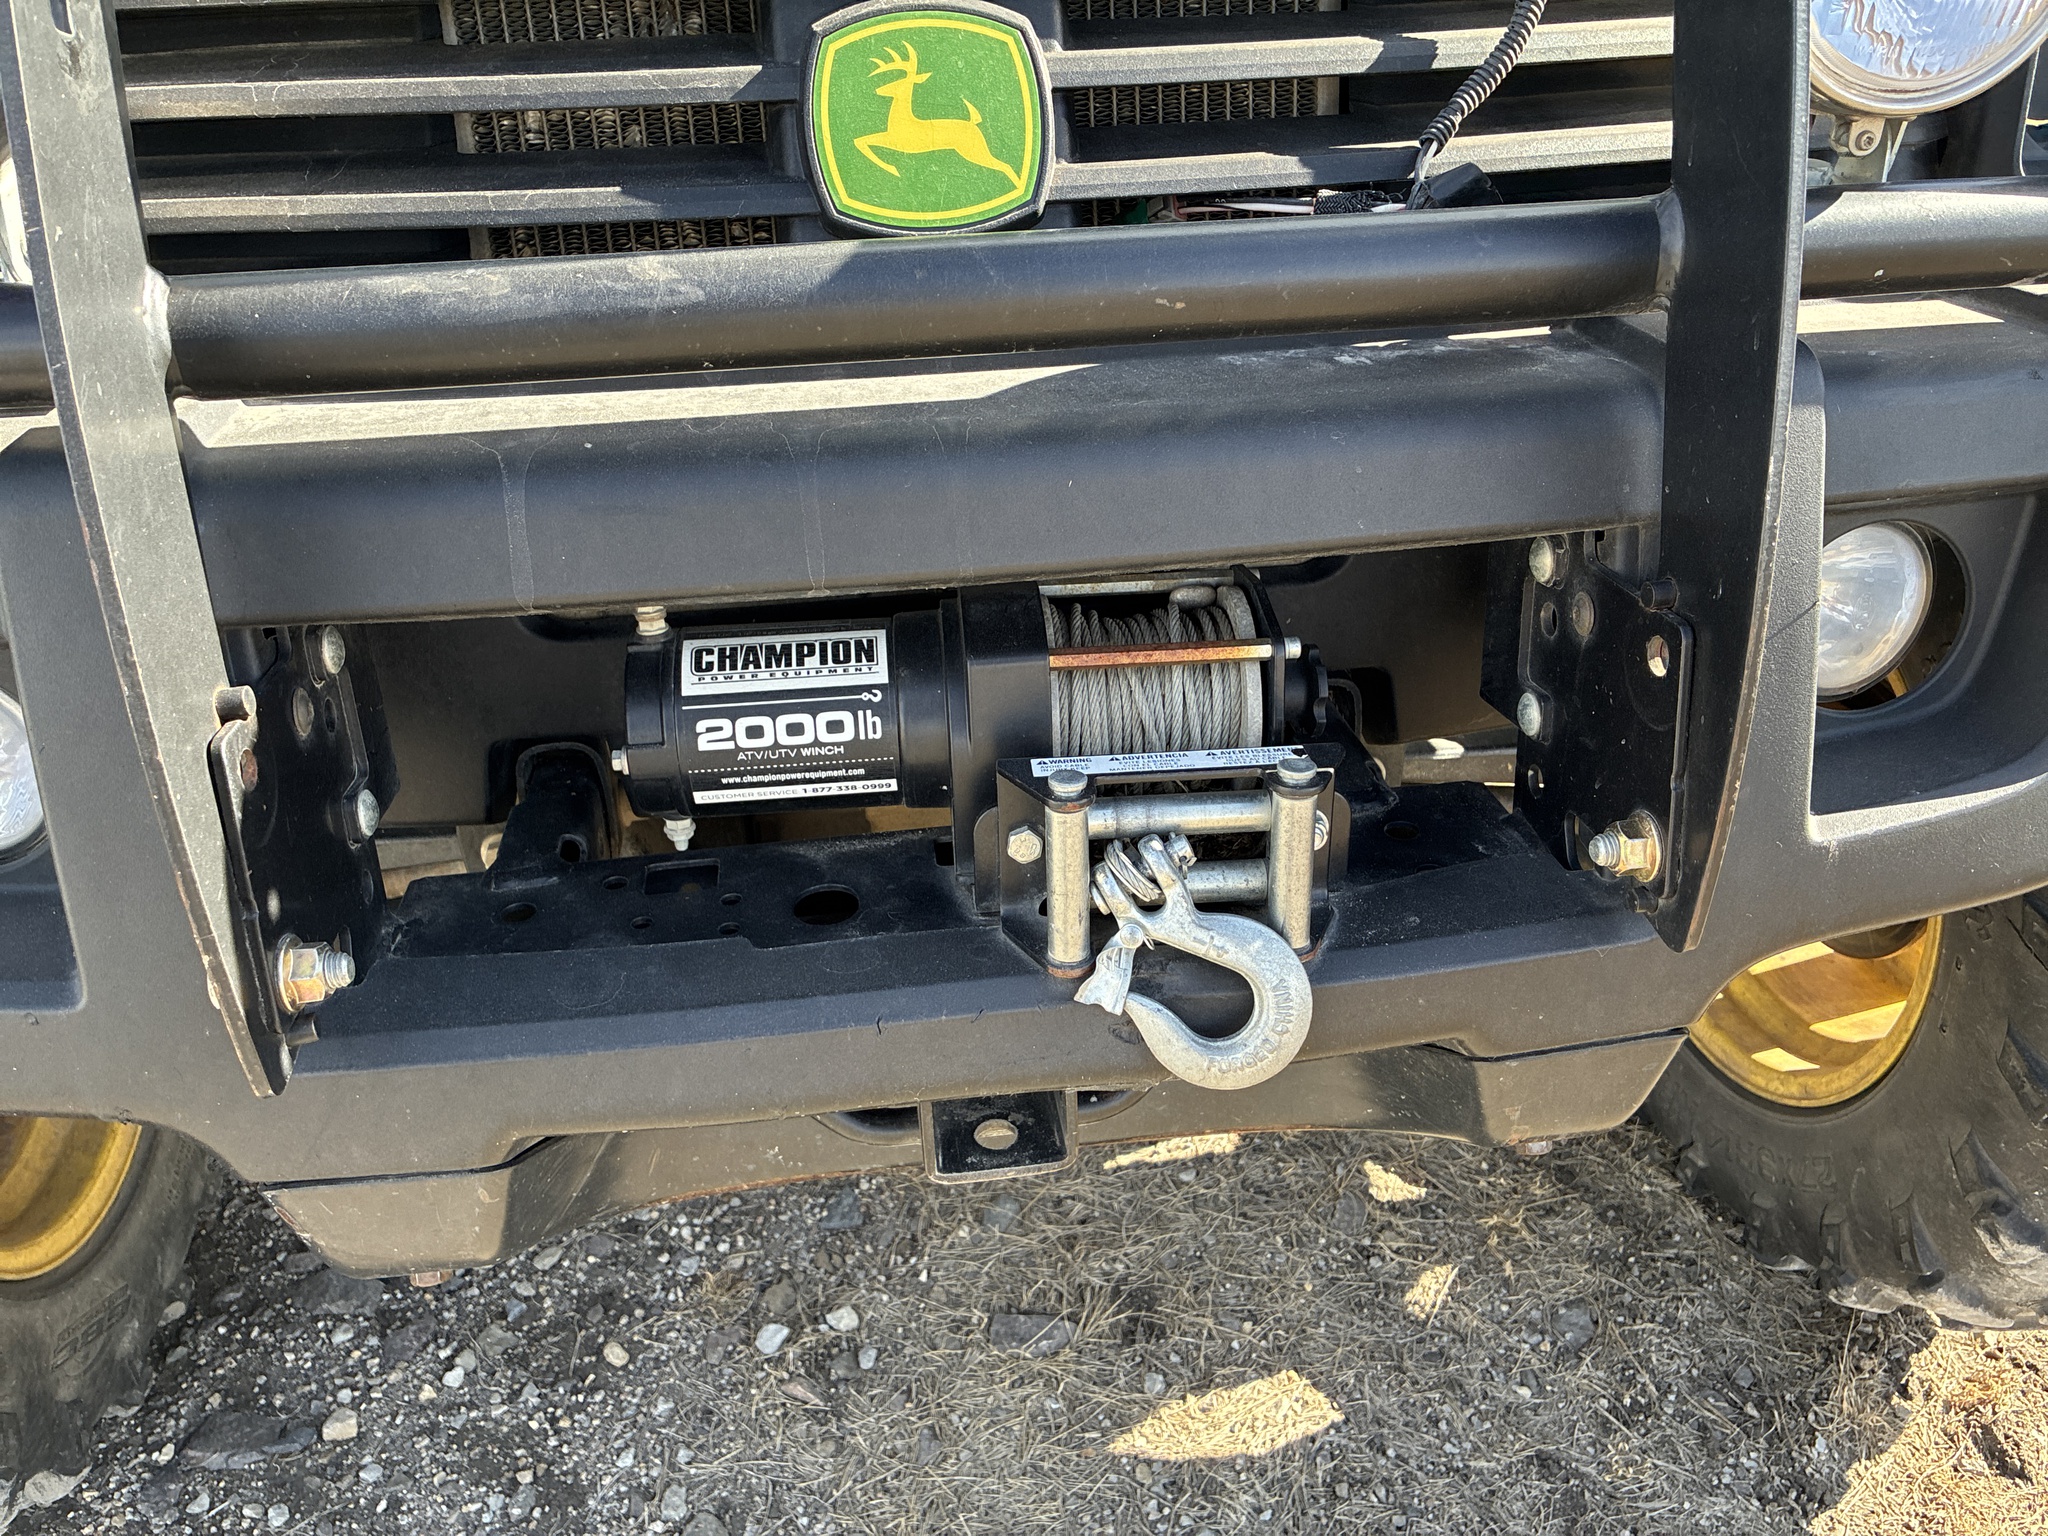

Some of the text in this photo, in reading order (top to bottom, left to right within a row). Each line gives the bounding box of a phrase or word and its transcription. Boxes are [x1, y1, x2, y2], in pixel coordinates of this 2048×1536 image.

[694, 638, 875, 673] CHAMPION
[698, 666, 873, 682] POWER EQUIPMENT
[737, 745, 845, 761] ATV/UTV WINCH
[1122, 753, 1189, 761] ADVERTENCIA
[1220, 747, 1294, 755] AVERTISSEMEN
[1048, 757, 1092, 765] WARNING
[721, 768, 865, 785] www.championpowerequipment.com
[701, 782, 892, 801] CUSTOMER SERVICE 1-877-338-0999
[1271, 978, 1295, 1036] CHINA
[1207, 1037, 1277, 1073] FORGED
